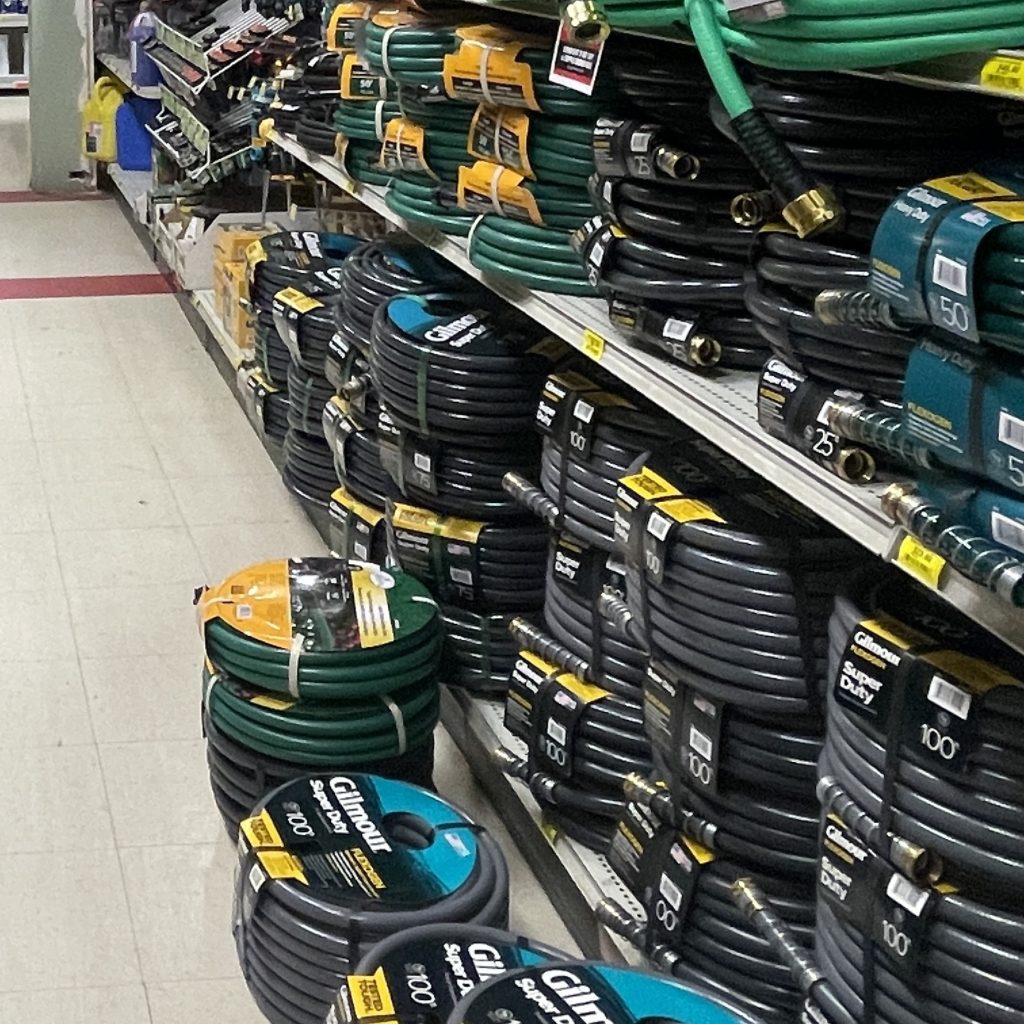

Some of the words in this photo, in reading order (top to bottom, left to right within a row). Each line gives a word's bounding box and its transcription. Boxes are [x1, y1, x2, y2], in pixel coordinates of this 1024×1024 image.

[853, 630, 902, 667] Gilmour
[838, 674, 875, 706] Duty
[841, 660, 884, 693] Super
[309, 779, 335, 811] Super
[325, 810, 351, 835] Duty
[329, 776, 393, 854] Gilmour
[442, 942, 468, 979] Super
[514, 977, 562, 1014] Super
